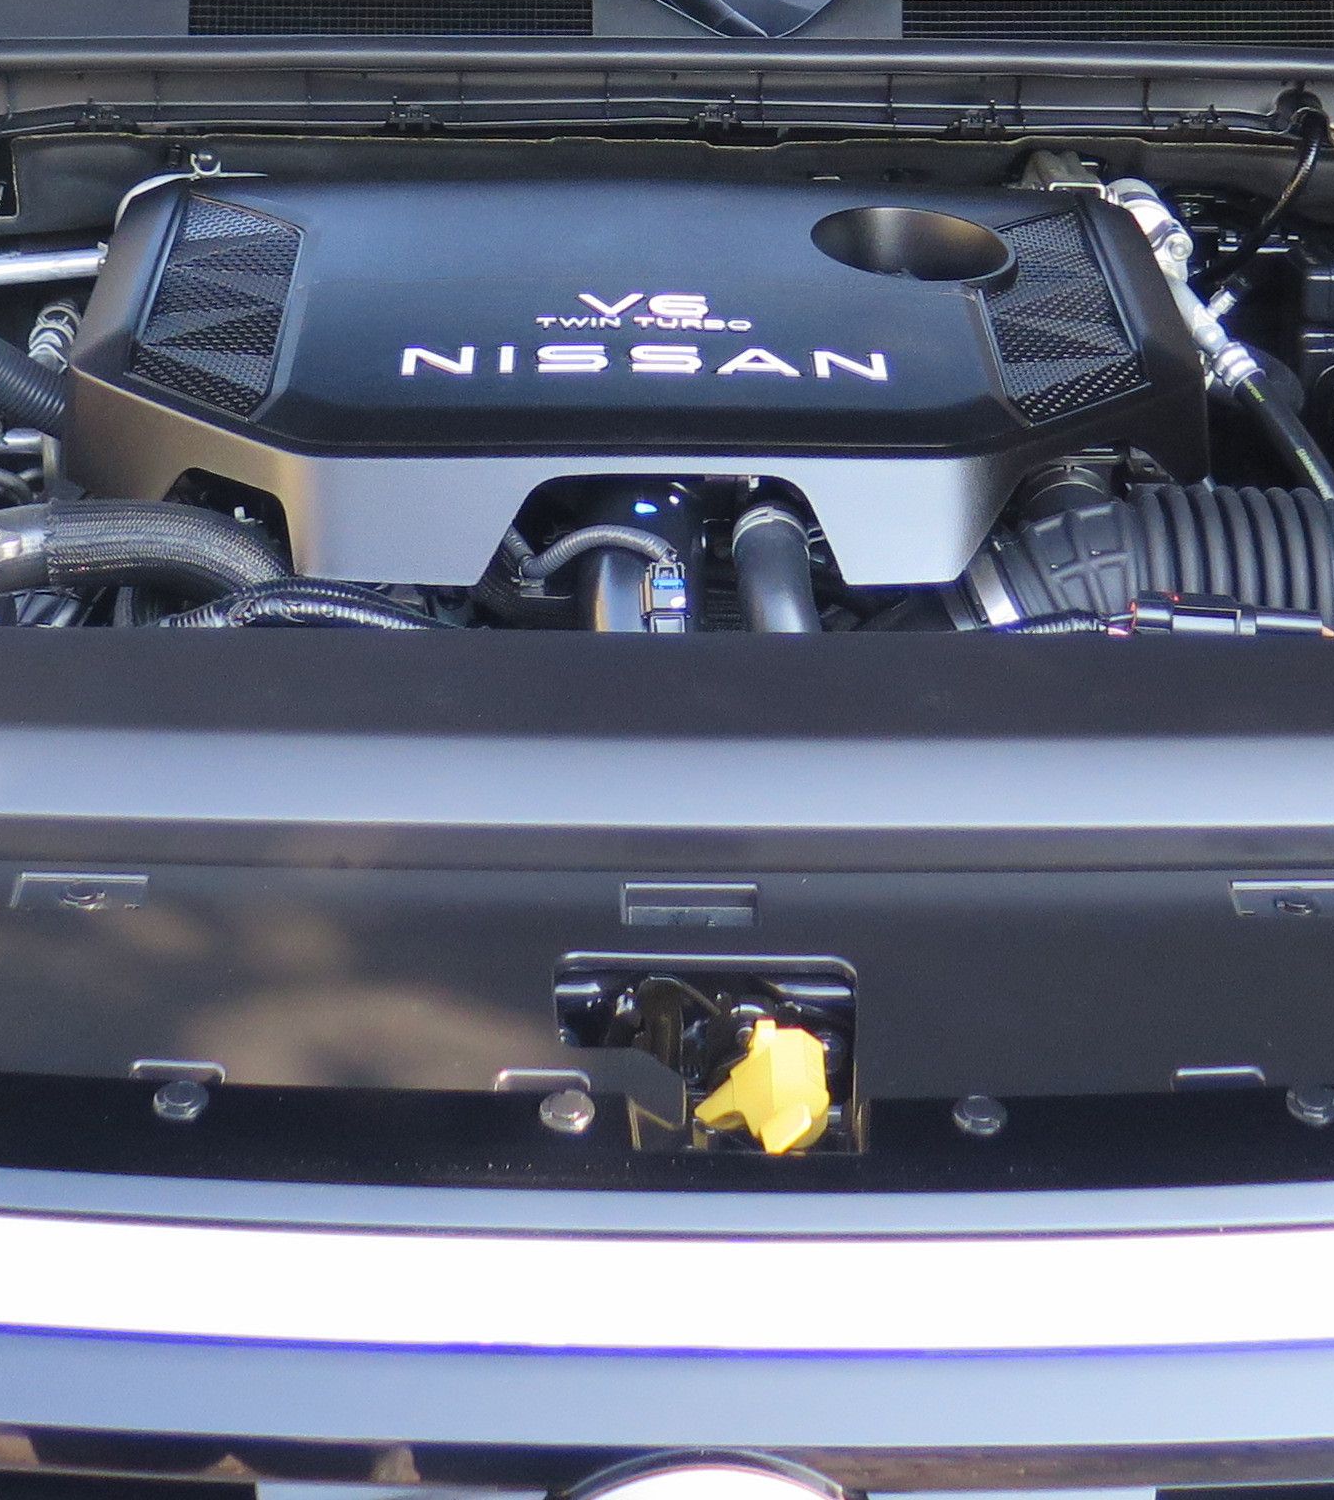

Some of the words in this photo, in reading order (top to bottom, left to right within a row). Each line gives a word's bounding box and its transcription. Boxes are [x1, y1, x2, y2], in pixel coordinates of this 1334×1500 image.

[578, 293, 710, 319] V6
[535, 316, 621, 329] TWIN
[633, 316, 752, 332] TURBO
[400, 344, 888, 381] NISSAN
